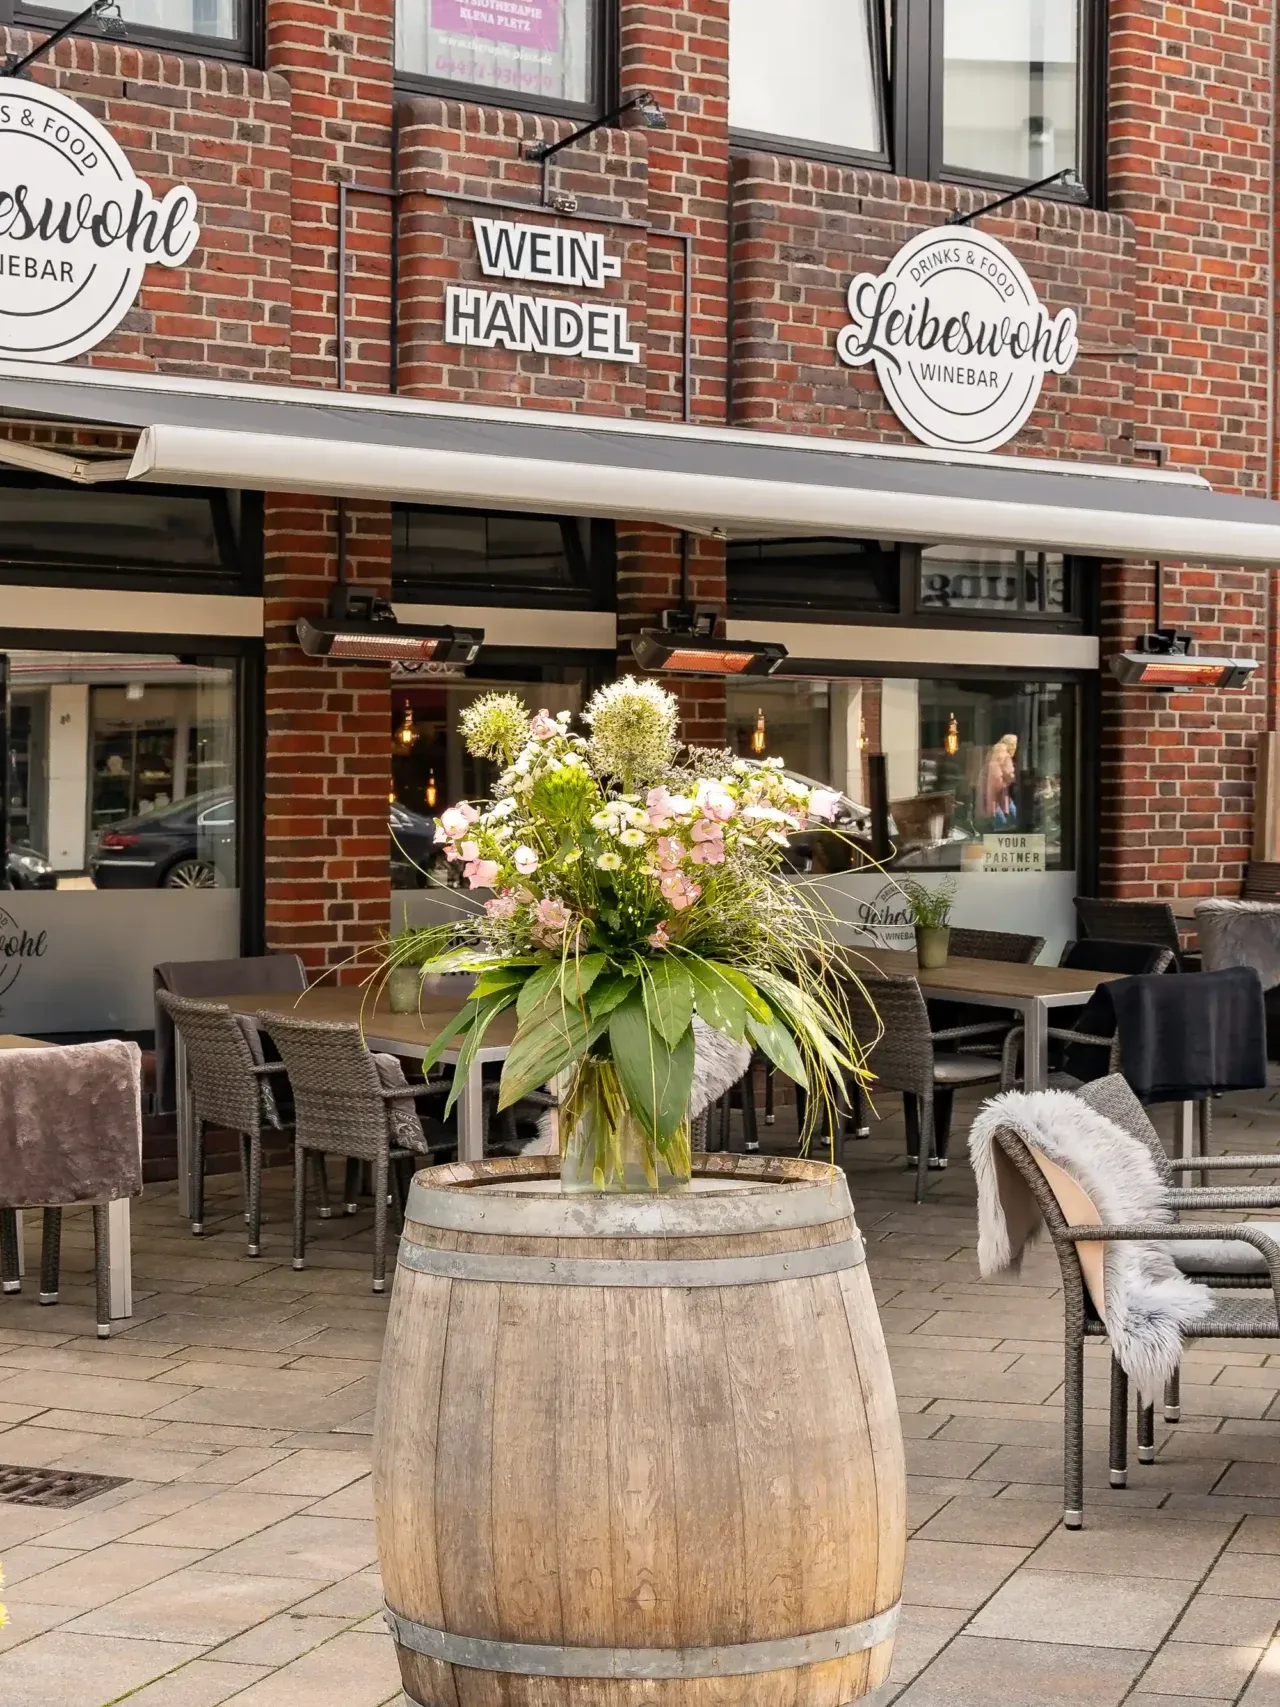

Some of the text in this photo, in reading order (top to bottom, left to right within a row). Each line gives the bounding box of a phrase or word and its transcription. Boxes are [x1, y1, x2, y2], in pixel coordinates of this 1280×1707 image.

[459, 8, 531, 32] ELENA PLETZ
[20, 108, 40, 128] &
[43, 117, 98, 169] FOOD
[480, 225, 615, 281] WEIN-
[910, 248, 1016, 298] DRINKS & FOOD
[452, 293, 634, 356] HANDEL
[845, 281, 1073, 375] Leibeswohl
[920, 362, 999, 389] WINEBAR
[985, 852, 1040, 863] PARTNER
[997, 837, 1026, 848] YOUR
[885, 932, 917, 940] WINEBA
